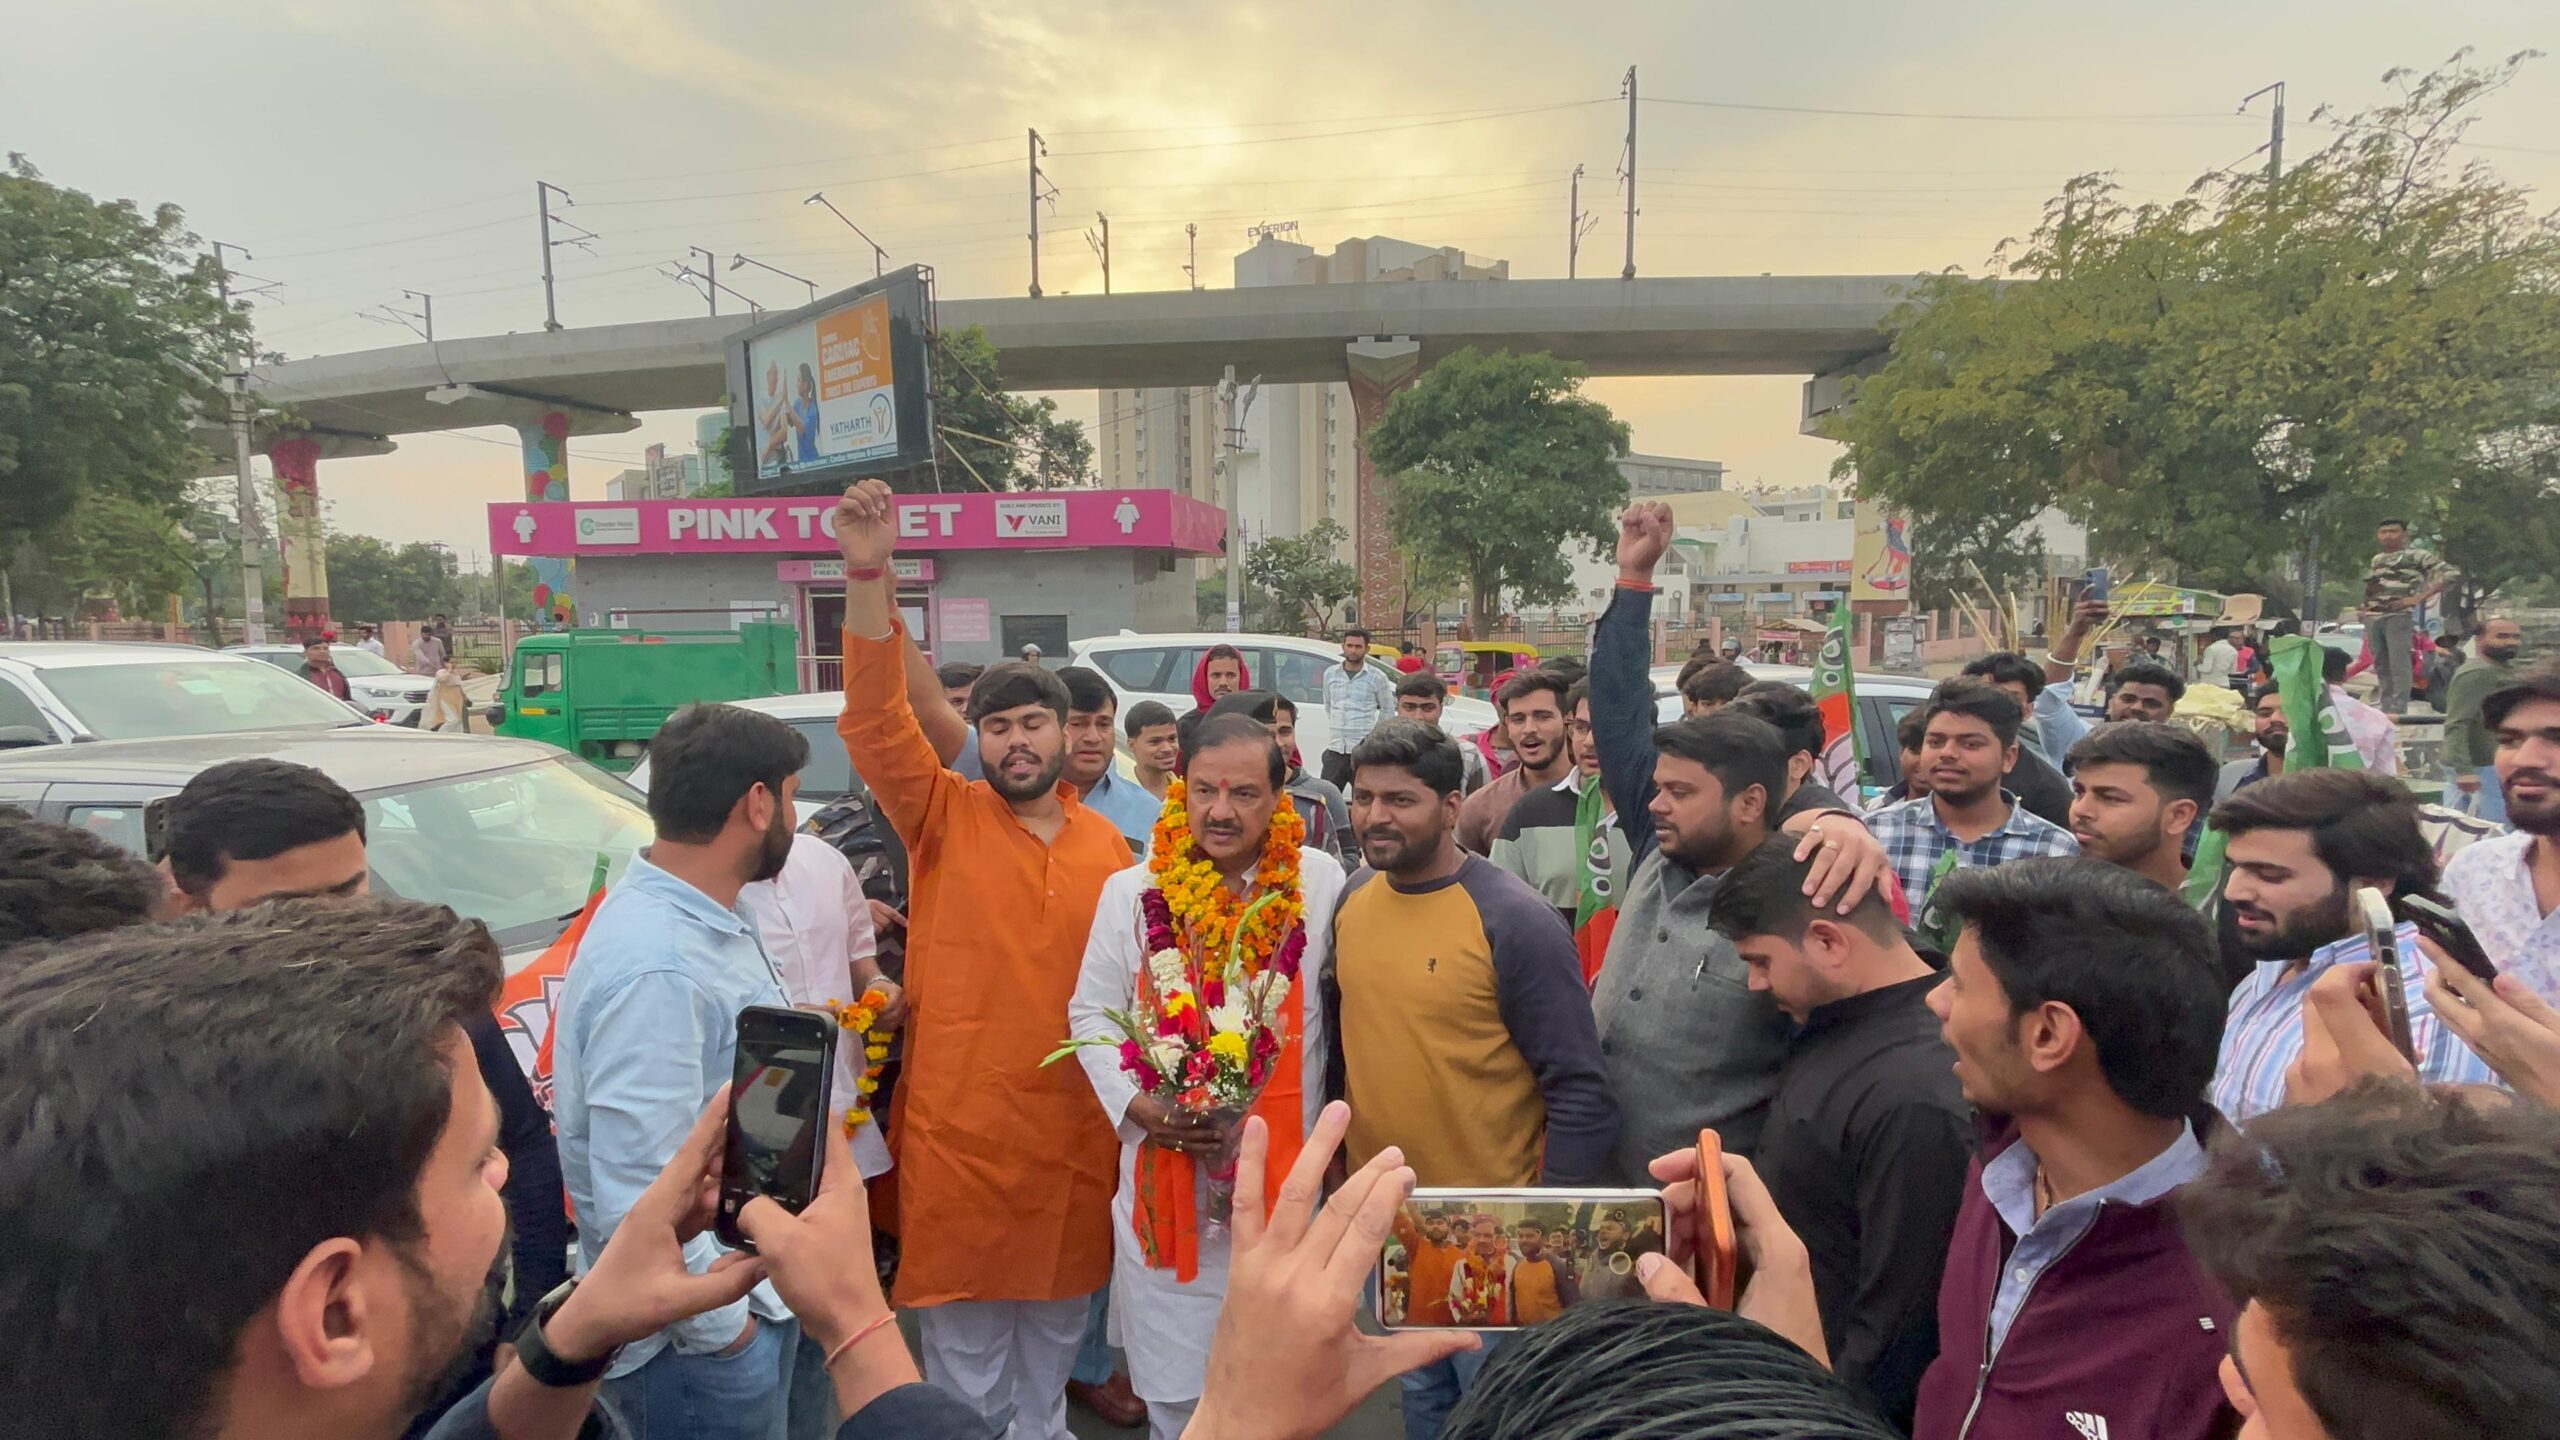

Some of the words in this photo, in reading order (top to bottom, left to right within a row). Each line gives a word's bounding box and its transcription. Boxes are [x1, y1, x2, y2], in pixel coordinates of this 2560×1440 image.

[1248, 220, 1298, 237] EXPERION
[830, 416, 872, 435] YATHARTH
[668, 507, 779, 540] PINK
[1028, 515, 1060, 525] VANI
